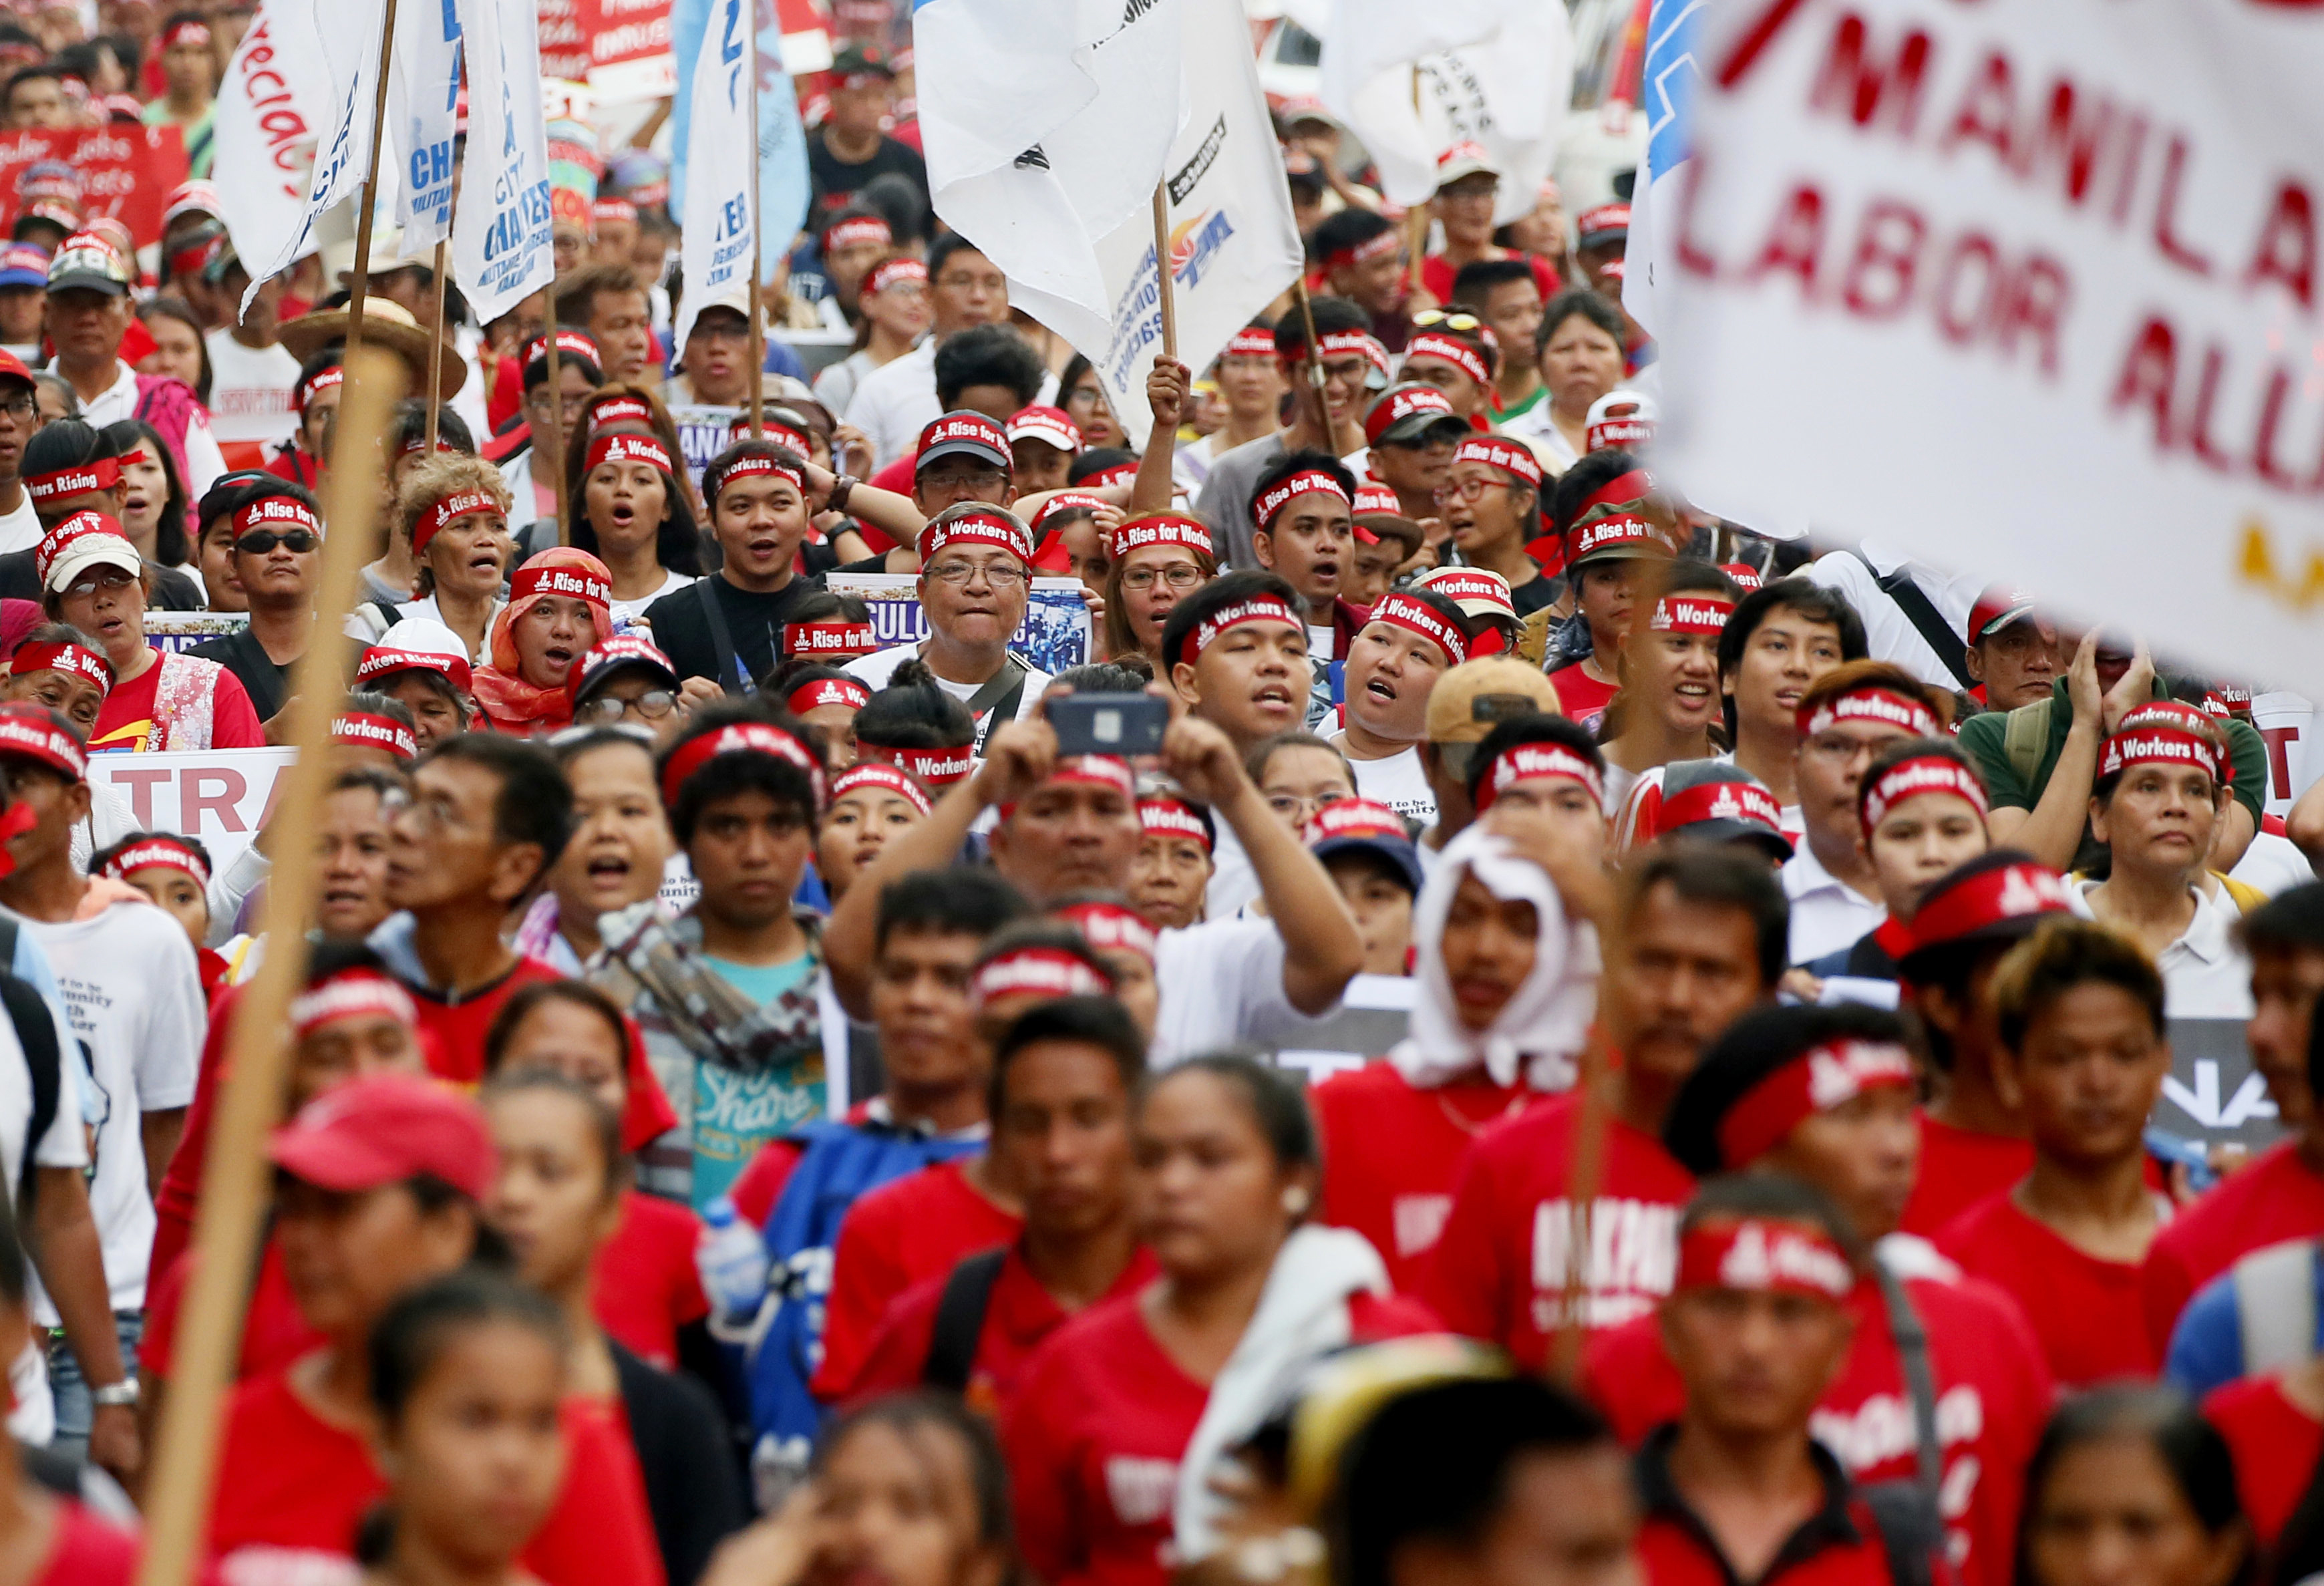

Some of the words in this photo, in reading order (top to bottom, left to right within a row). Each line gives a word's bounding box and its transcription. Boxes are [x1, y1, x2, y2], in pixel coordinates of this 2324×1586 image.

[1809, 11, 2321, 313] MANILA
[1677, 152, 2071, 389] LABOR
[949, 422, 979, 437] Rise
[981, 426, 995, 442] for
[56, 473, 98, 492] Rising
[1266, 486, 1289, 506] Rise
[1291, 475, 1309, 496] for
[264, 502, 295, 520] Rise
[297, 504, 311, 522] for
[450, 493, 478, 513] Rise
[55, 516, 85, 539] Rise
[949, 520, 1007, 541] Workers
[1129, 526, 1156, 546] Rise
[1159, 523, 1178, 539] for
[1596, 522, 1623, 541] Rise
[1626, 519, 1643, 536] for
[41, 534, 57, 555] for
[554, 572, 583, 593] Rise
[586, 577, 600, 597] for
[1432, 578, 1492, 595] Workers
[1212, 601, 1281, 623] Workers
[812, 630, 842, 649] Rise
[845, 629, 860, 647] for
[1388, 598, 1443, 636] Workers
[1443, 628, 1466, 665] Rising
[404, 653, 451, 671] Rising
[1836, 695, 1911, 724] Workers
[331, 718, 393, 740] Workers
[2123, 737, 2190, 758] Workers
[915, 756, 967, 775] Workers
[834, 769, 899, 790] Workers
[659, 885, 696, 897] unit
